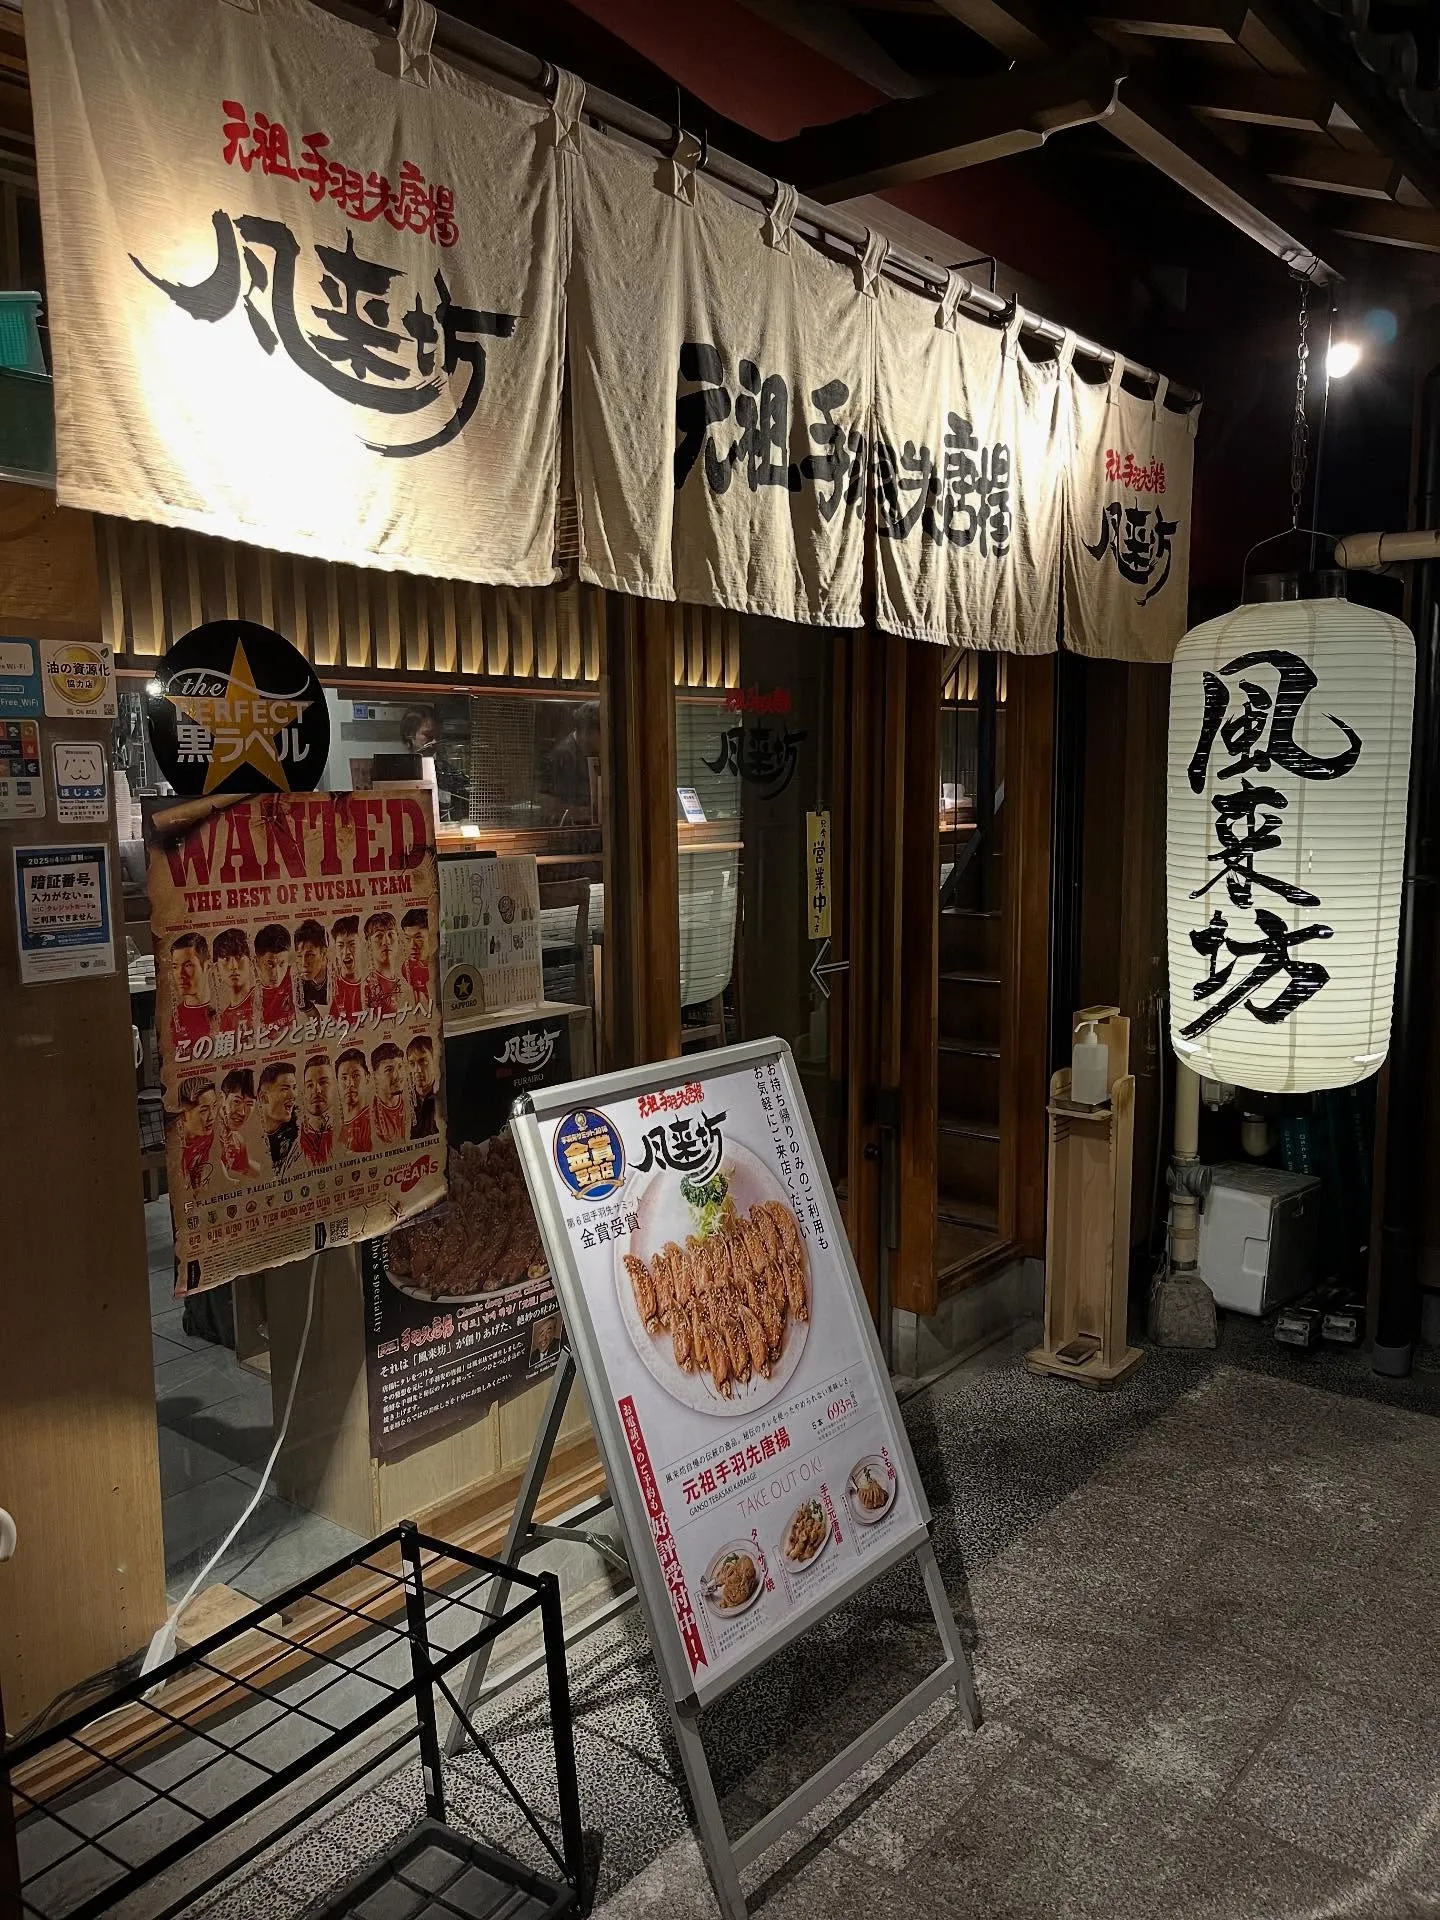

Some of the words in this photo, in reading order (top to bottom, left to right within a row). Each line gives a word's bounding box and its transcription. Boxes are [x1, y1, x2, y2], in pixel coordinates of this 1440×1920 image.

[47, 661, 110, 677] 油の資源化
[67, 680, 93, 688] 協力店
[181, 673, 226, 696] the
[176, 700, 314, 723] PERFECT
[177, 725, 310, 763] 黒ラベル
[165, 798, 426, 887] WANTED
[1179, 649, 1362, 1040] 風来坊
[184, 891, 221, 912] THE
[227, 887, 268, 909] BEST
[277, 884, 299, 904] OF
[305, 879, 365, 902] FUTSAL
[369, 875, 412, 897] TEAM
[450, 999, 478, 1011] SAPPORO
[753, 1065, 811, 1239] お気軽にご来店ください
[766, 1062, 829, 1250] お持ち帰りのみのご利用も
[384, 1162, 438, 1186] OCEANS
[580, 1212, 640, 1249] 金賞受賞
[682, 1426, 792, 1505] 元祖手羽先唐揚
[690, 1501, 709, 1517] GANSO
[737, 1487, 770, 1518] TAKE
[770, 1471, 799, 1501] OUT
